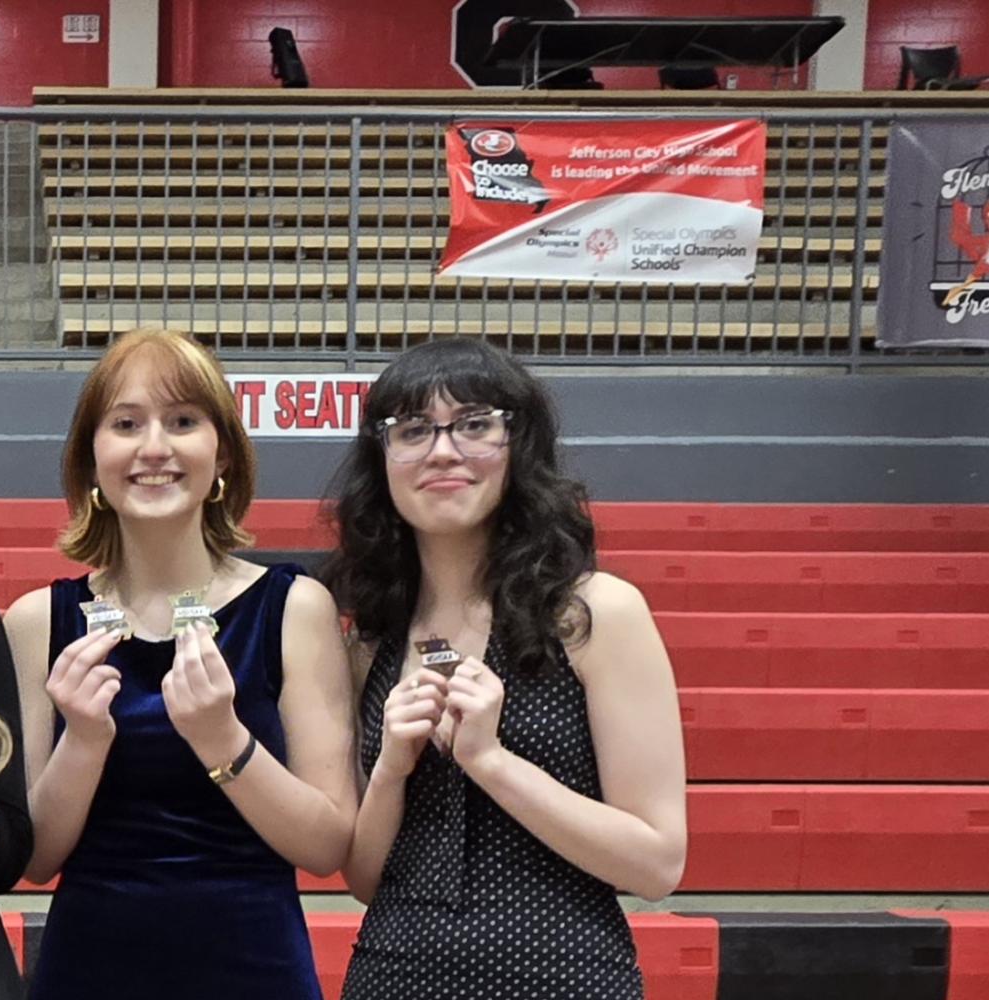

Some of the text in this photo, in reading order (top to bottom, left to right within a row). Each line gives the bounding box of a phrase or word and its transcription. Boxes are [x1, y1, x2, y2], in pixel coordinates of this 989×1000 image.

[568, 145, 631, 160] Jefferson
[472, 159, 528, 177] Choose
[551, 165, 562, 178] is
[565, 165, 612, 179] leading
[687, 164, 758, 177] Movement
[633, 225, 737, 242] Special Olympics
[632, 243, 747, 259] Unified Champion
[631, 257, 681, 271] Schools
